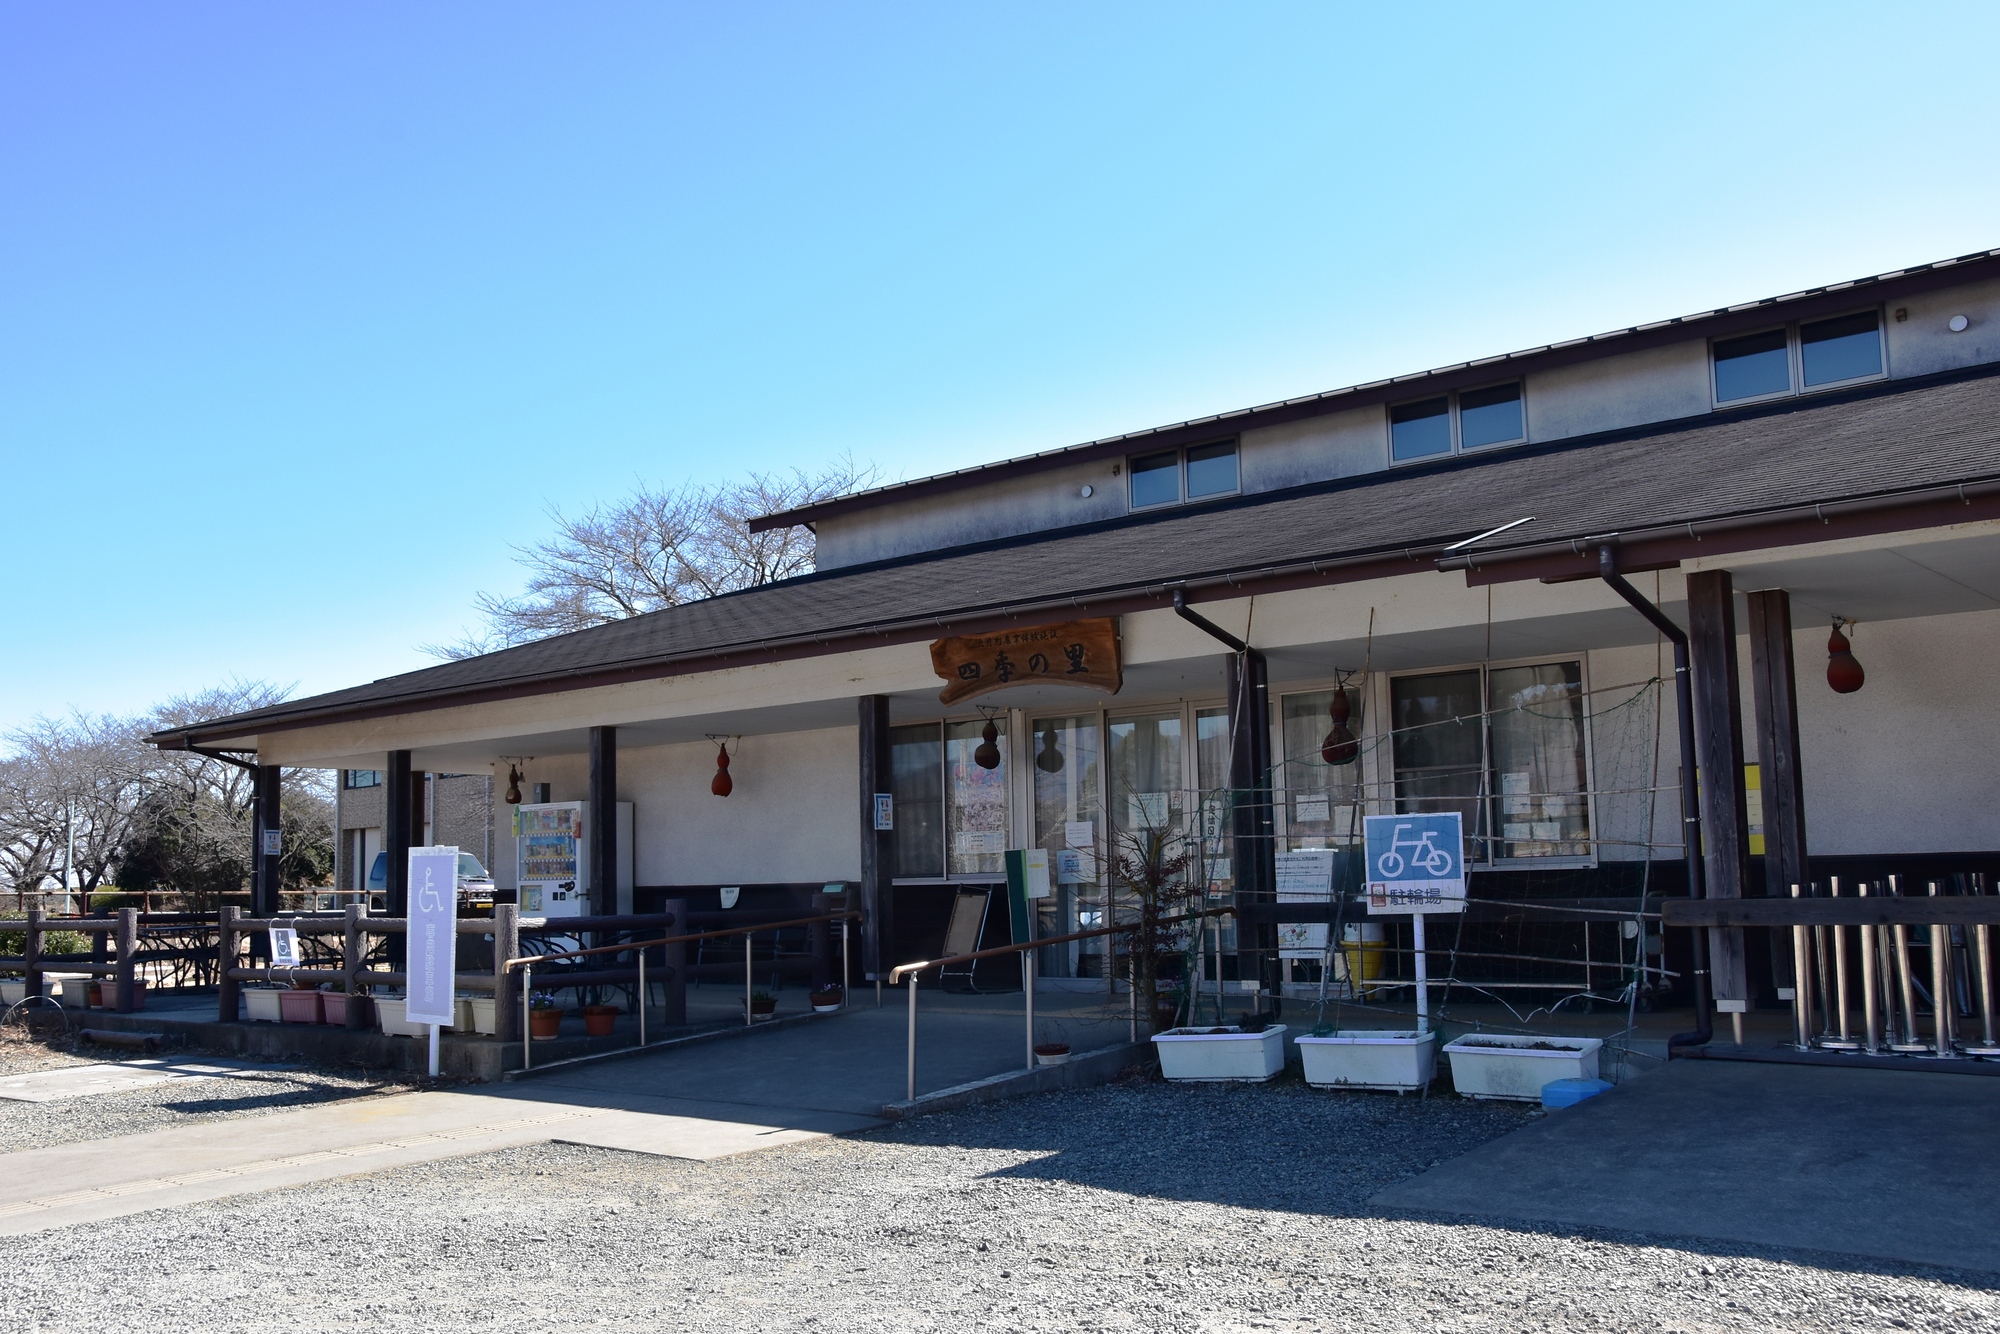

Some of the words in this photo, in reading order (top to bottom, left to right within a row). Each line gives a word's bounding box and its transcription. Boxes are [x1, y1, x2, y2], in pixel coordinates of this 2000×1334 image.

[957, 643, 1090, 683] 四季の里
[1389, 888, 1442, 906] 駐輪場
